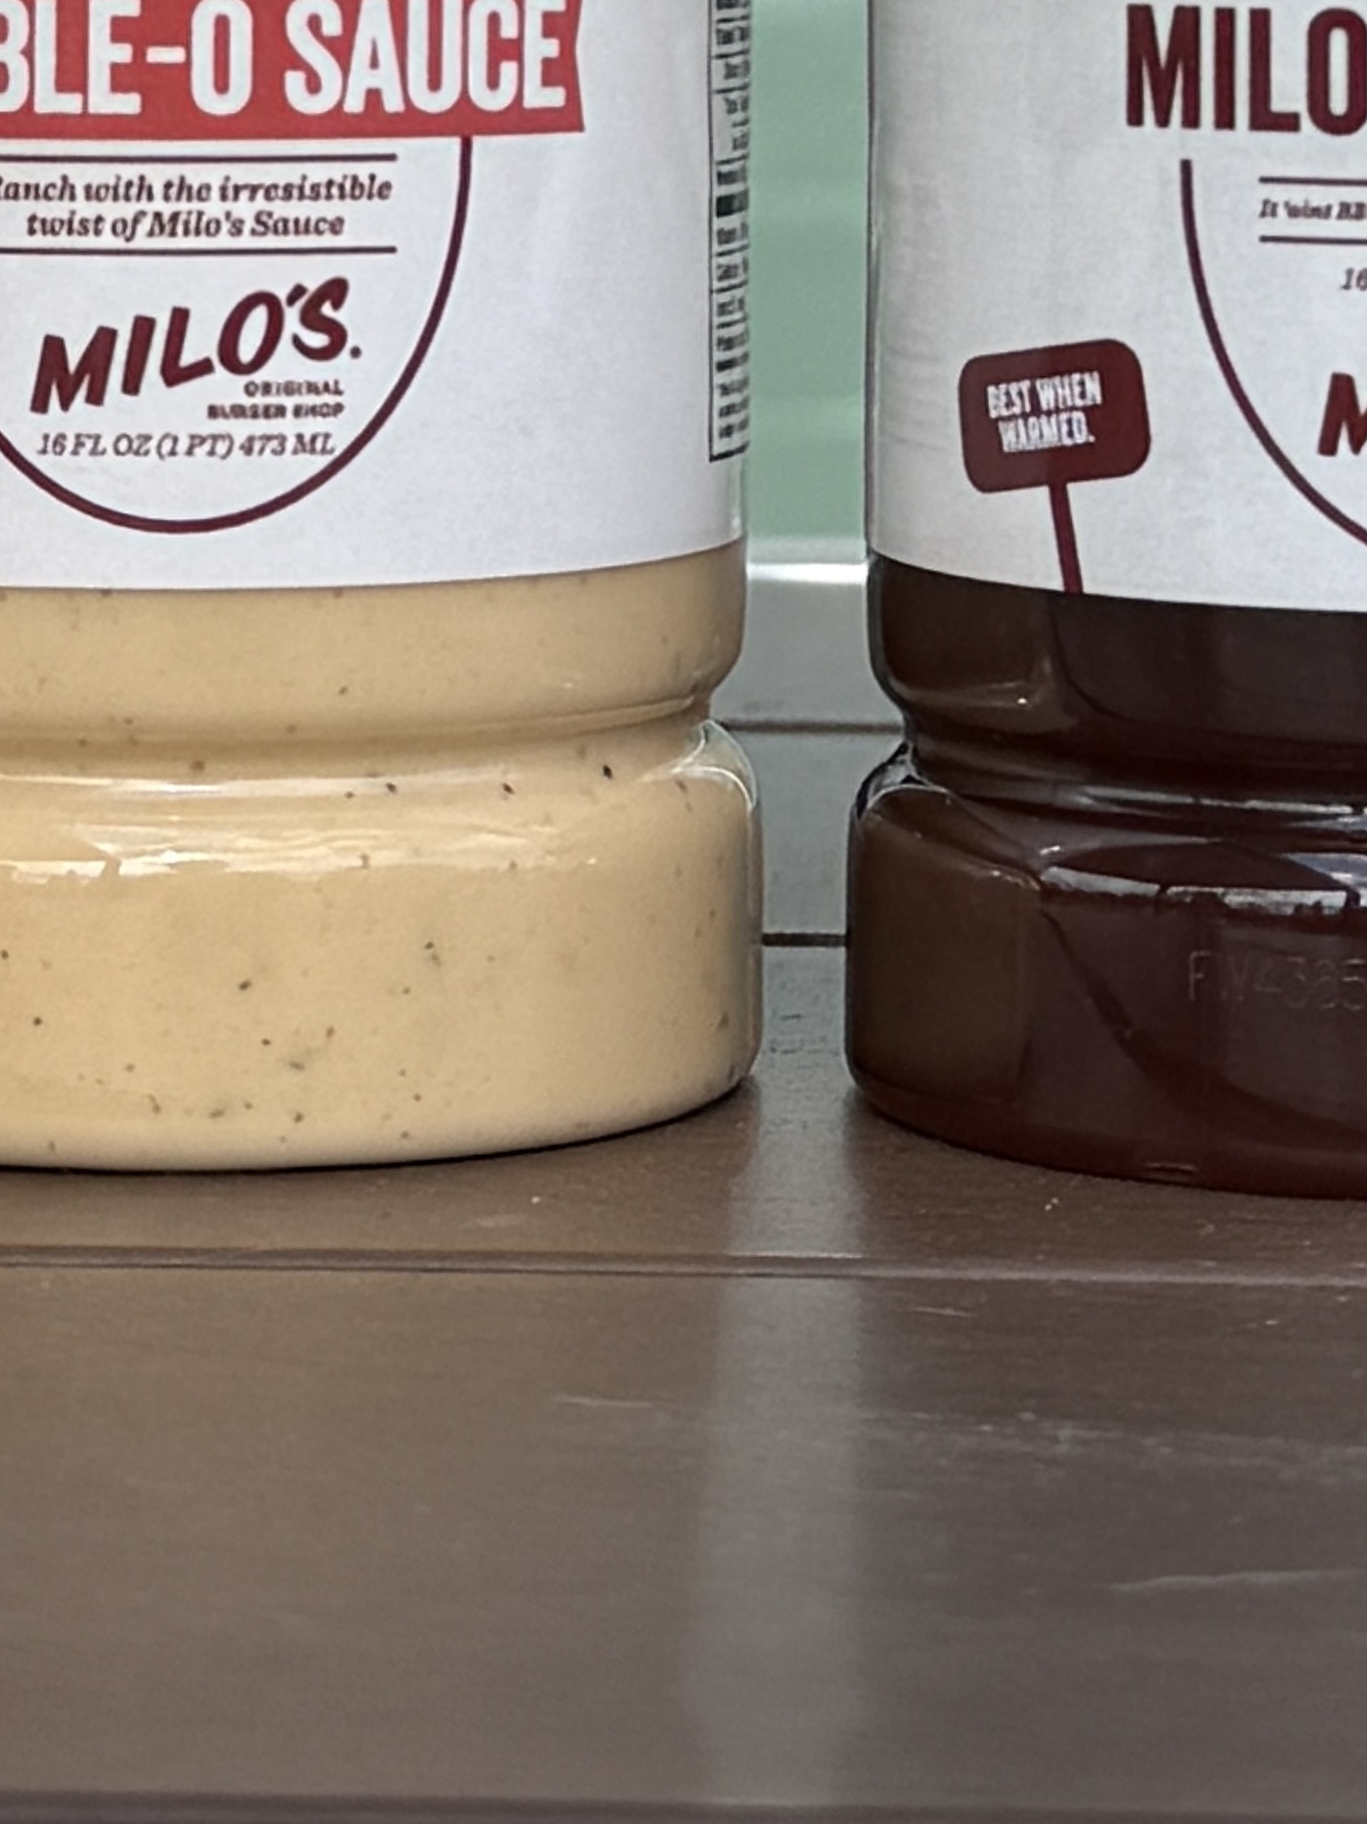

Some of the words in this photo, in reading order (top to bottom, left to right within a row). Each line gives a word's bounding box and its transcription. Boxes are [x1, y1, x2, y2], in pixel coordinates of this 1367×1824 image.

[83, 174, 155, 203] with
[162, 174, 212, 203] the
[218, 173, 393, 203] irresistible
[26, 211, 106, 237] twist
[110, 210, 148, 242] of
[146, 210, 245, 239] Milo's
[250, 211, 345, 237] Sauce
[987, 379, 1031, 419] BEST
[1035, 370, 1103, 411] WHEN
[36, 433, 69, 456] 16
[70, 433, 108, 456] FL
[113, 433, 155, 456] OZ
[184, 433, 235, 460] PT)
[239, 433, 286, 456] 473
[290, 433, 336, 456] ML
